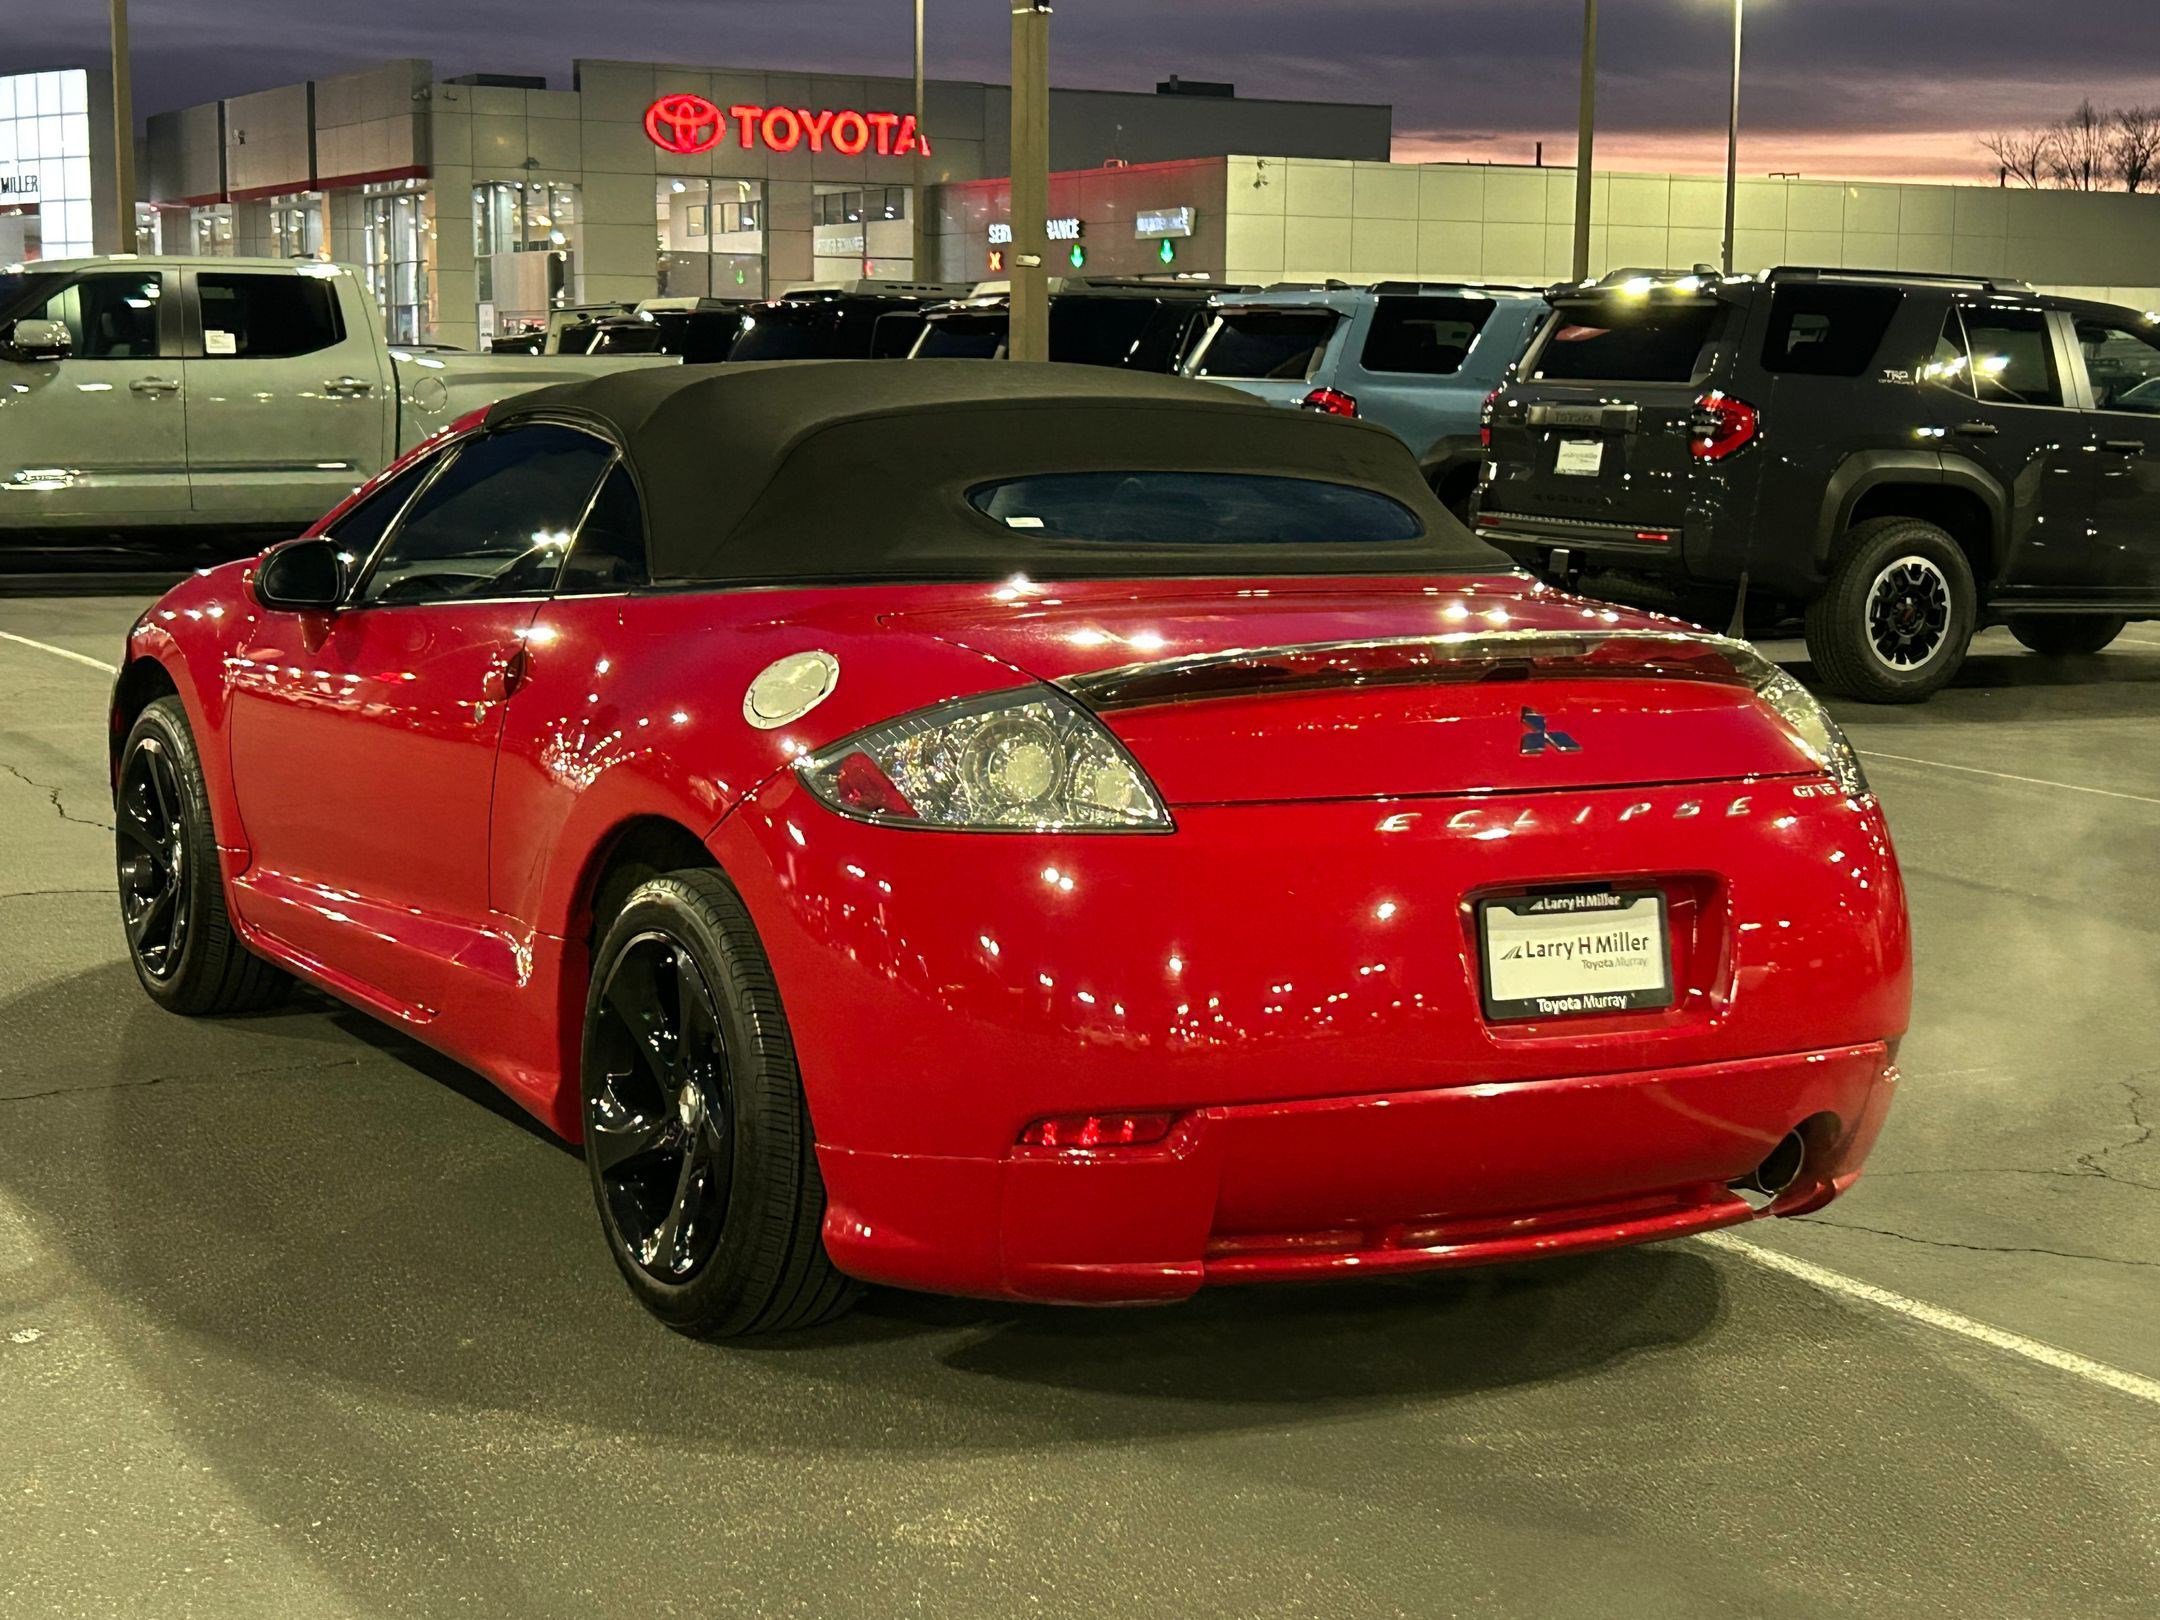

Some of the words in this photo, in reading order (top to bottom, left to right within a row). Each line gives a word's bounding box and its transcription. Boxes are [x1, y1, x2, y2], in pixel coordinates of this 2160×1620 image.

[730, 105, 931, 156] TOYOTA
[1, 175, 38, 193] MILLER
[1375, 797, 1753, 832] ECLIPSE
[1544, 897, 1574, 911] Larry
[1575, 895, 1585, 907] H
[1586, 893, 1621, 907] Miller
[1526, 940, 1574, 960] Larry
[1578, 936, 1592, 955] H
[1595, 931, 1650, 954] Miller
[1581, 958, 1614, 970] Toyota
[1614, 957, 1648, 968] Murray
[1536, 997, 1582, 1015] Toyota
[1583, 994, 1628, 1010] Murray
